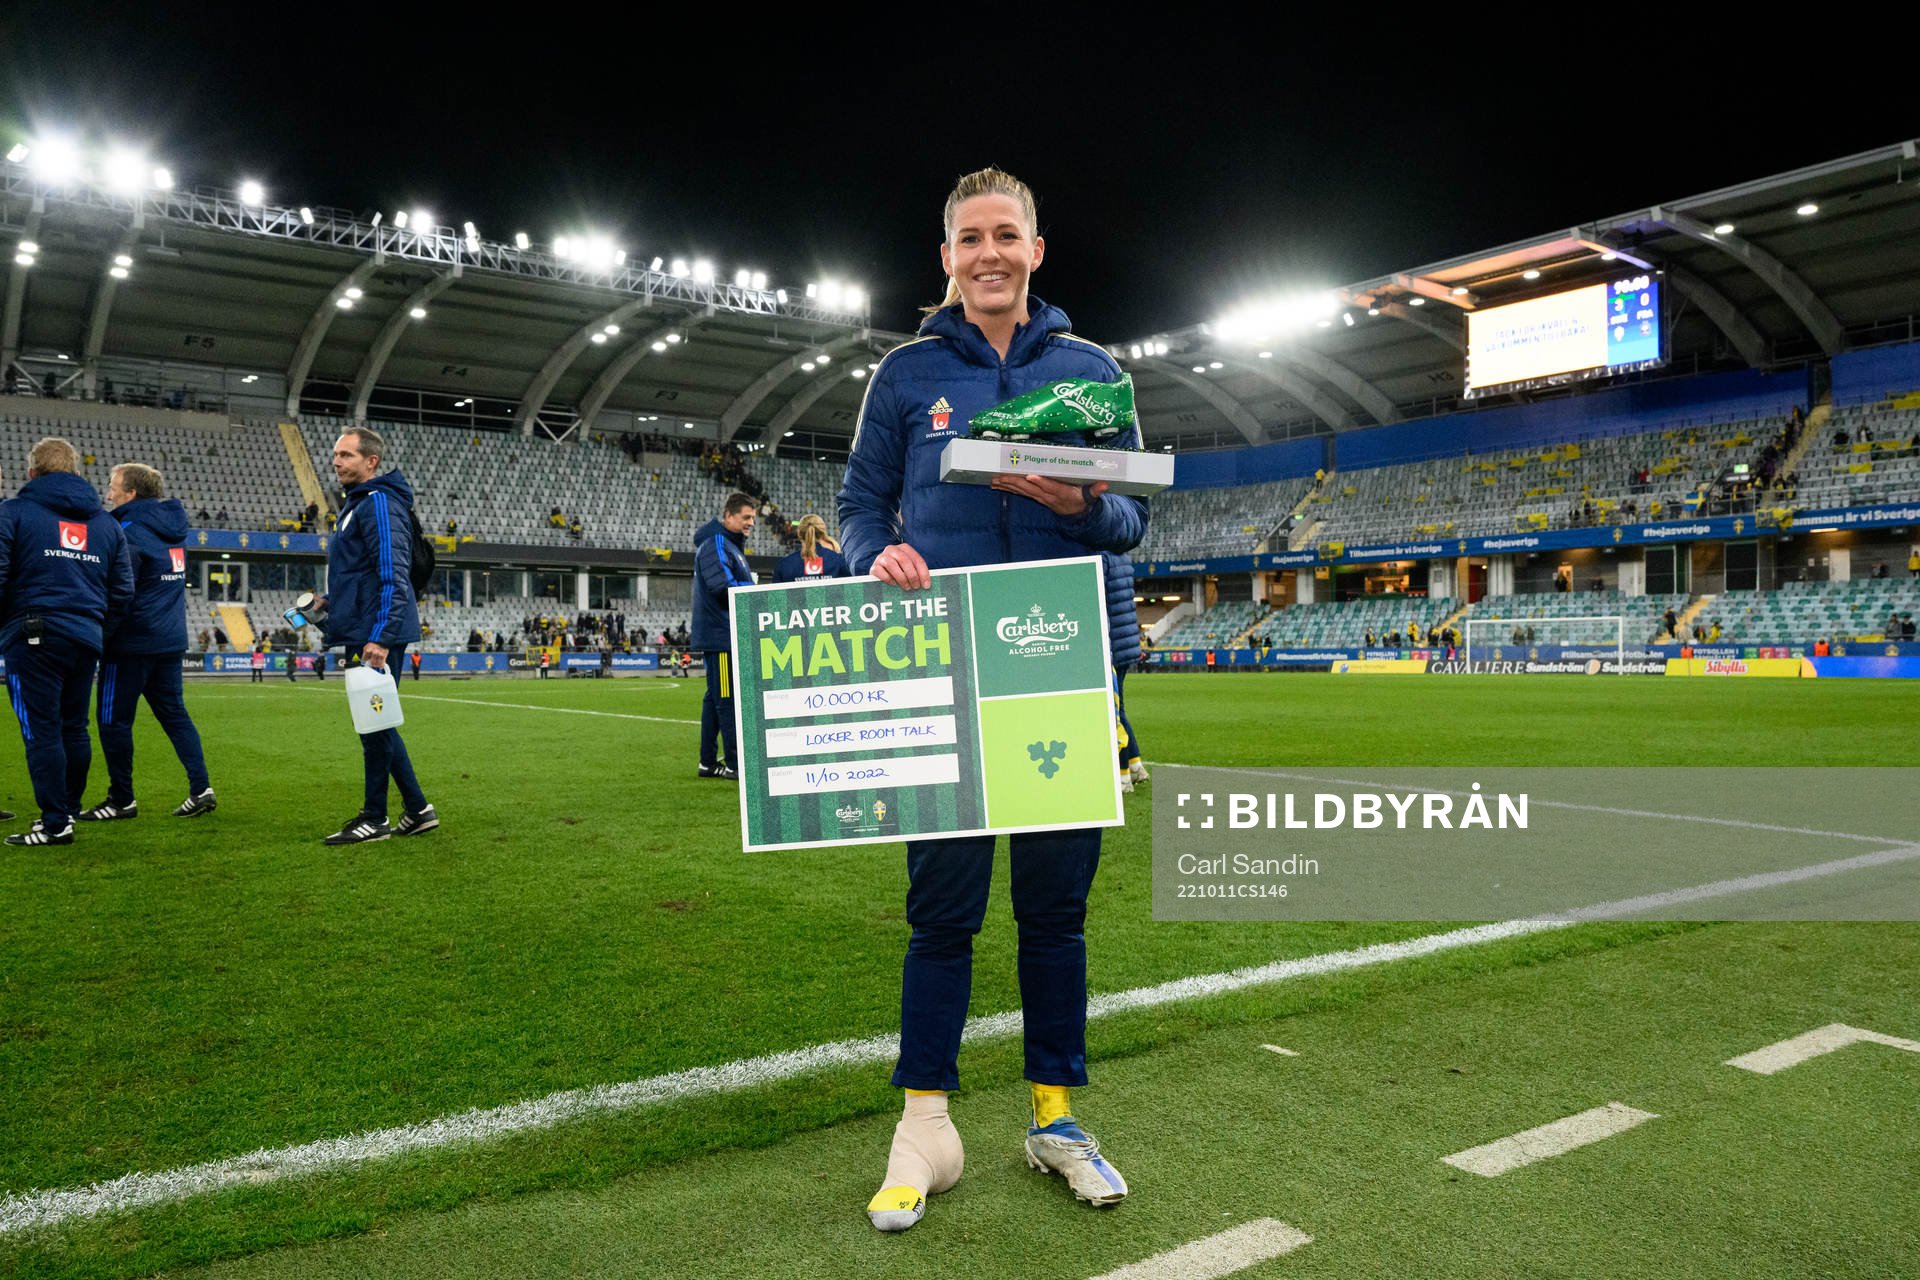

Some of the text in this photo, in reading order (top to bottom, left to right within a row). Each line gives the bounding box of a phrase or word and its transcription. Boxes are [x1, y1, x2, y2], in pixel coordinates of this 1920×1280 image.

[183, 335, 215, 349] F5
[441, 365, 469, 377] F4
[1052, 382, 1116, 425] Carlsberg
[928, 407, 954, 415] adidas
[1024, 454, 1048, 464] Player
[1058, 457, 1069, 465] the
[1071, 458, 1094, 467] match
[1845, 511, 1858, 521] är
[1860, 510, 1872, 521] vi
[1643, 525, 1710, 537] #hejasverige
[1483, 537, 1539, 549] #hejasverige
[44, 550, 100, 563] SVENSKA SPEL
[1272, 554, 1314, 564] #hejasverige
[758, 597, 948, 631] PLAYER OF THE
[996, 616, 1079, 647] Carlsberg
[760, 622, 951, 680] MATCH
[1009, 646, 1047, 655] ALCOHOL
[1049, 644, 1070, 652] FREE
[1526, 662, 1585, 673] Sundström
[1705, 660, 1748, 676] Sibylla
[804, 689, 889, 709] 10.000 KR
[806, 724, 937, 746] LOCKER ROOM TALK
[806, 767, 890, 788] 11/10 2022
[836, 808, 863, 819] Carlsberg
